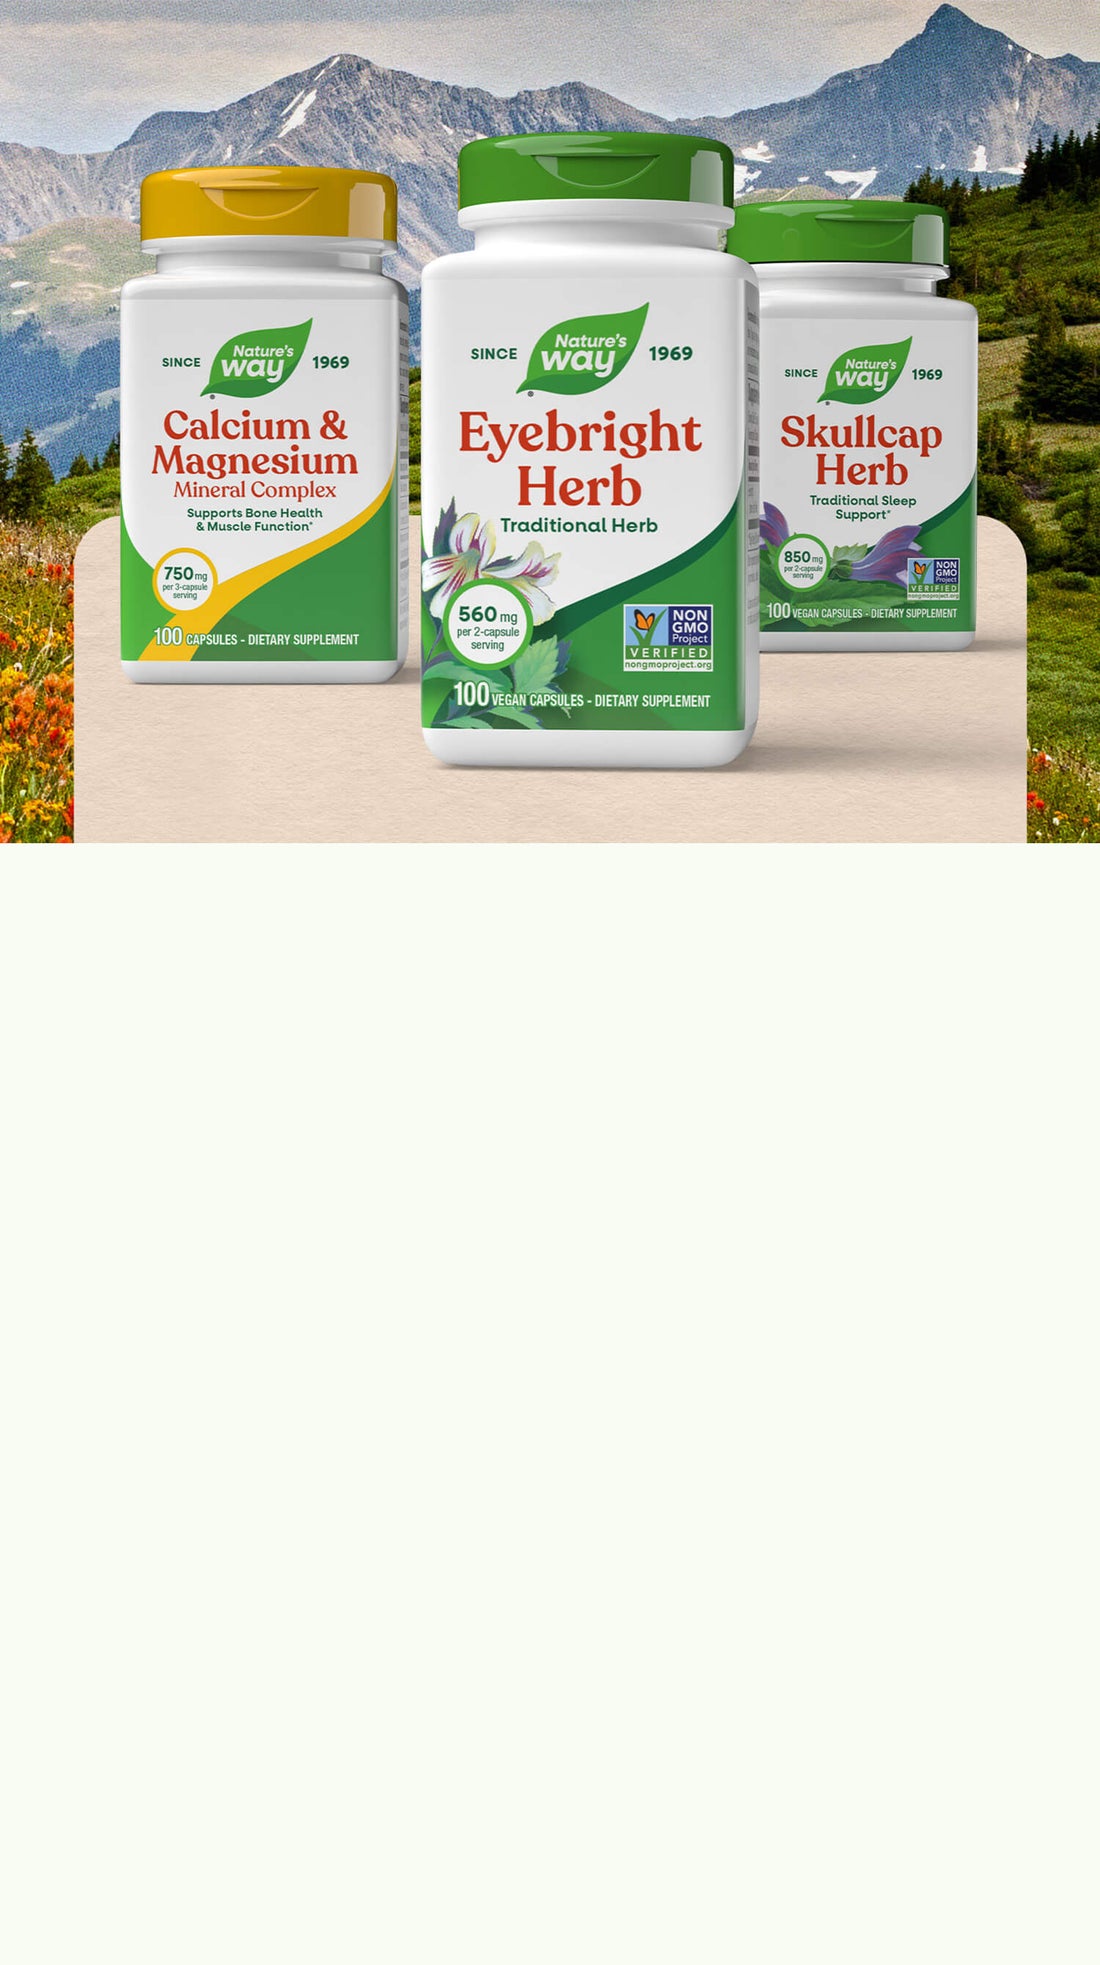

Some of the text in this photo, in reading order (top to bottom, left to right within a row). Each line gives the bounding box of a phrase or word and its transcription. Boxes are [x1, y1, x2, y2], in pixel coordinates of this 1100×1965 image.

[555, 334, 627, 348] Nature's
[233, 345, 294, 358] Nature's
[471, 348, 518, 360] SINCE
[649, 346, 693, 361] 1969
[162, 358, 200, 368] SINCE
[312, 356, 350, 369] 1969
[541, 350, 616, 378] way
[845, 358, 896, 370] Nature's
[221, 359, 284, 383] way
[784, 369, 818, 378] SINCE
[912, 369, 942, 380] 1969
[835, 370, 888, 392] way
[164, 409, 348, 440] Calcium &
[459, 408, 702, 463] Eyebright
[781, 414, 942, 457] Skullcap
[152, 444, 358, 479] Magnesium
[816, 452, 908, 485] Herb
[518, 463, 642, 506] Herb
[173, 481, 336, 502] Mineral Complex
[810, 495, 916, 508] Traditional Sleep
[187, 508, 322, 520] Supports Bone Health
[196, 522, 204, 531] &
[207, 522, 250, 531] Muscle
[500, 518, 658, 533] Traditional Herb
[784, 551, 810, 562] 850
[164, 567, 208, 582] 750 mg
[936, 568, 957, 576] GMO
[162, 583, 208, 592] per 3-capsule
[173, 591, 198, 600] serving
[458, 606, 517, 625] 560 mg
[674, 610, 707, 620] NON
[767, 602, 790, 618] 100
[792, 609, 819, 618] VEGAN
[822, 609, 862, 618] CAPSULES
[871, 608, 904, 618] DIETARY
[906, 608, 957, 618] SUPPLEMENT
[458, 626, 520, 638] per 2-capsule
[672, 622, 708, 633] GMO
[154, 626, 182, 646] 100
[186, 634, 237, 646] CAPSULES
[248, 634, 290, 645] DIETARY
[293, 634, 359, 645] SUPPLEMENT
[672, 634, 708, 645] Project
[471, 640, 504, 652] serving
[630, 648, 708, 658] VERIFIED
[625, 660, 712, 670] nongmoproject.org
[454, 681, 490, 706] 100
[492, 694, 526, 706] VEGAN
[530, 694, 584, 706] CAPSULES
[595, 694, 638, 707] DIETARY
[642, 694, 710, 707] SUPPLEMENT
